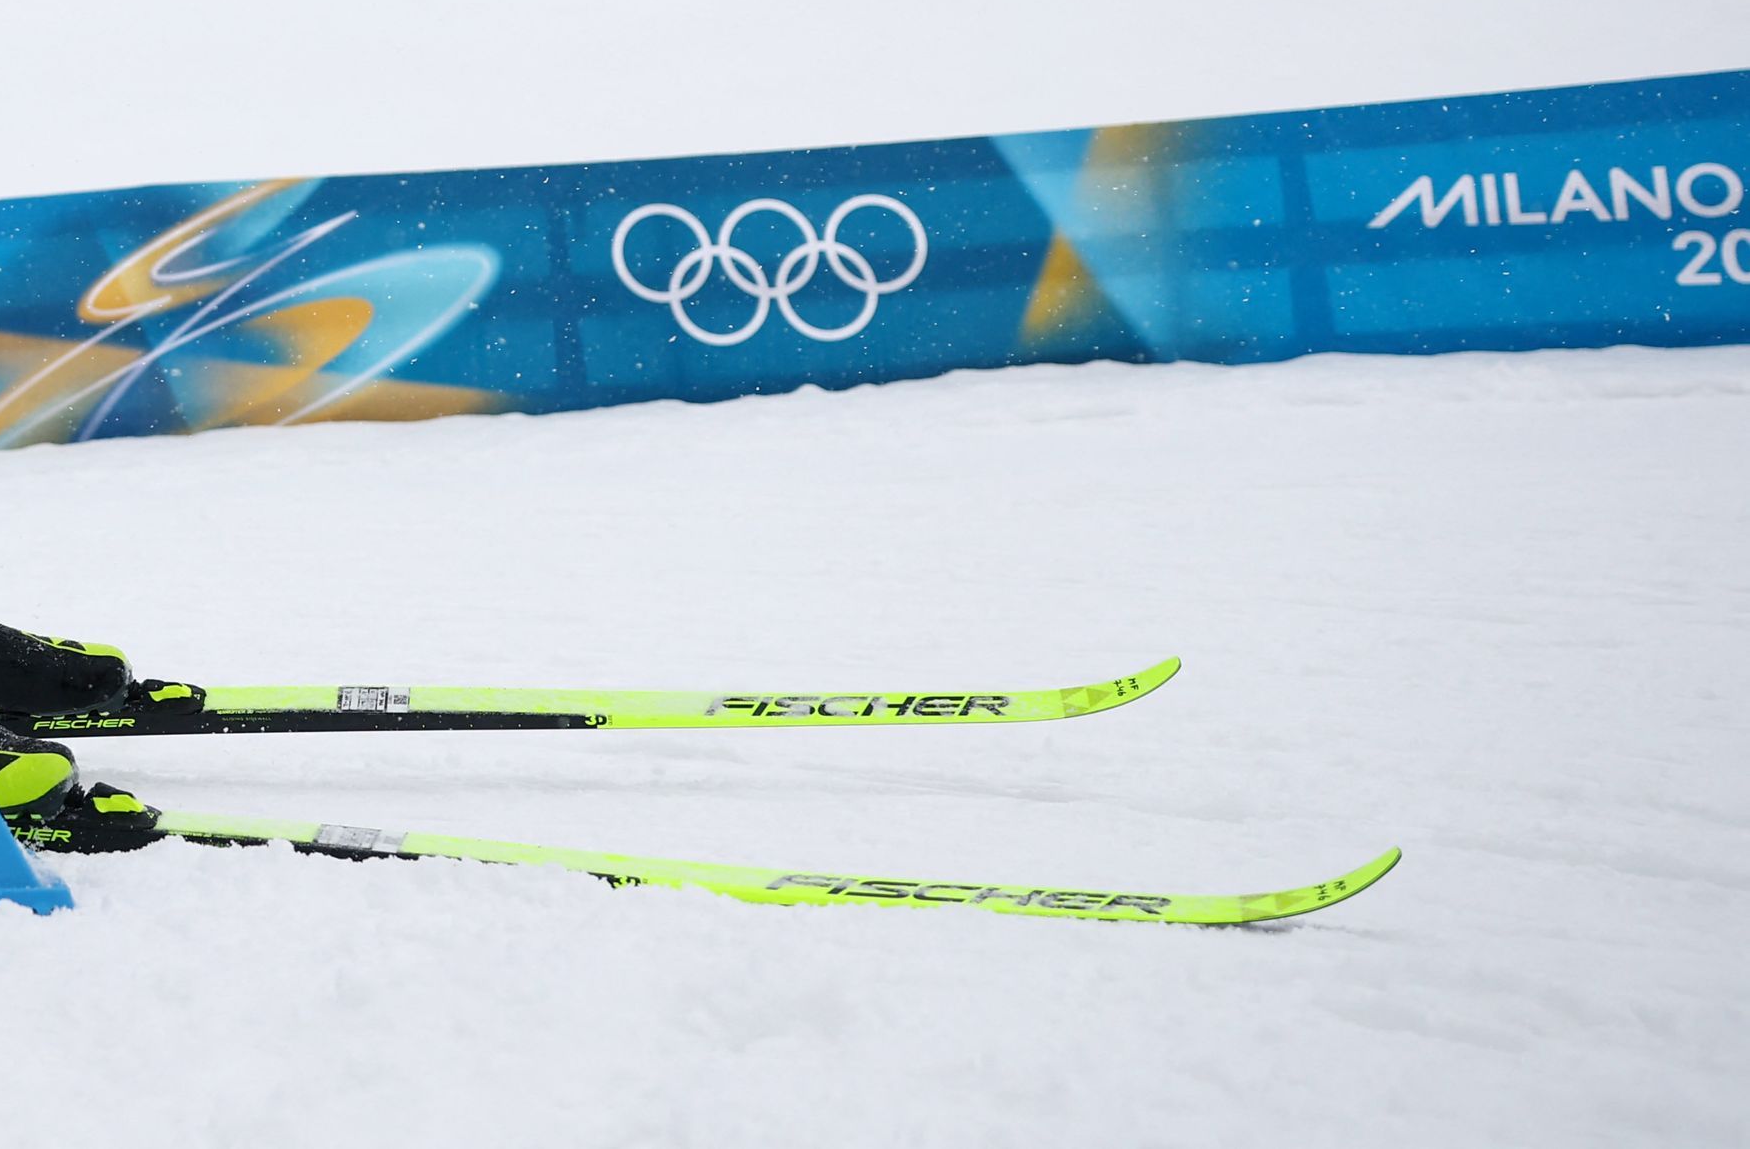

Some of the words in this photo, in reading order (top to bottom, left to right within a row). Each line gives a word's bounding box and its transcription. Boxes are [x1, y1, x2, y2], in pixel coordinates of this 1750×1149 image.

[1366, 161, 1745, 230] MILANO
[703, 695, 1010, 717] FISCHER
[33, 718, 136, 731] FISCHER
[765, 873, 1172, 915] FISCHER
